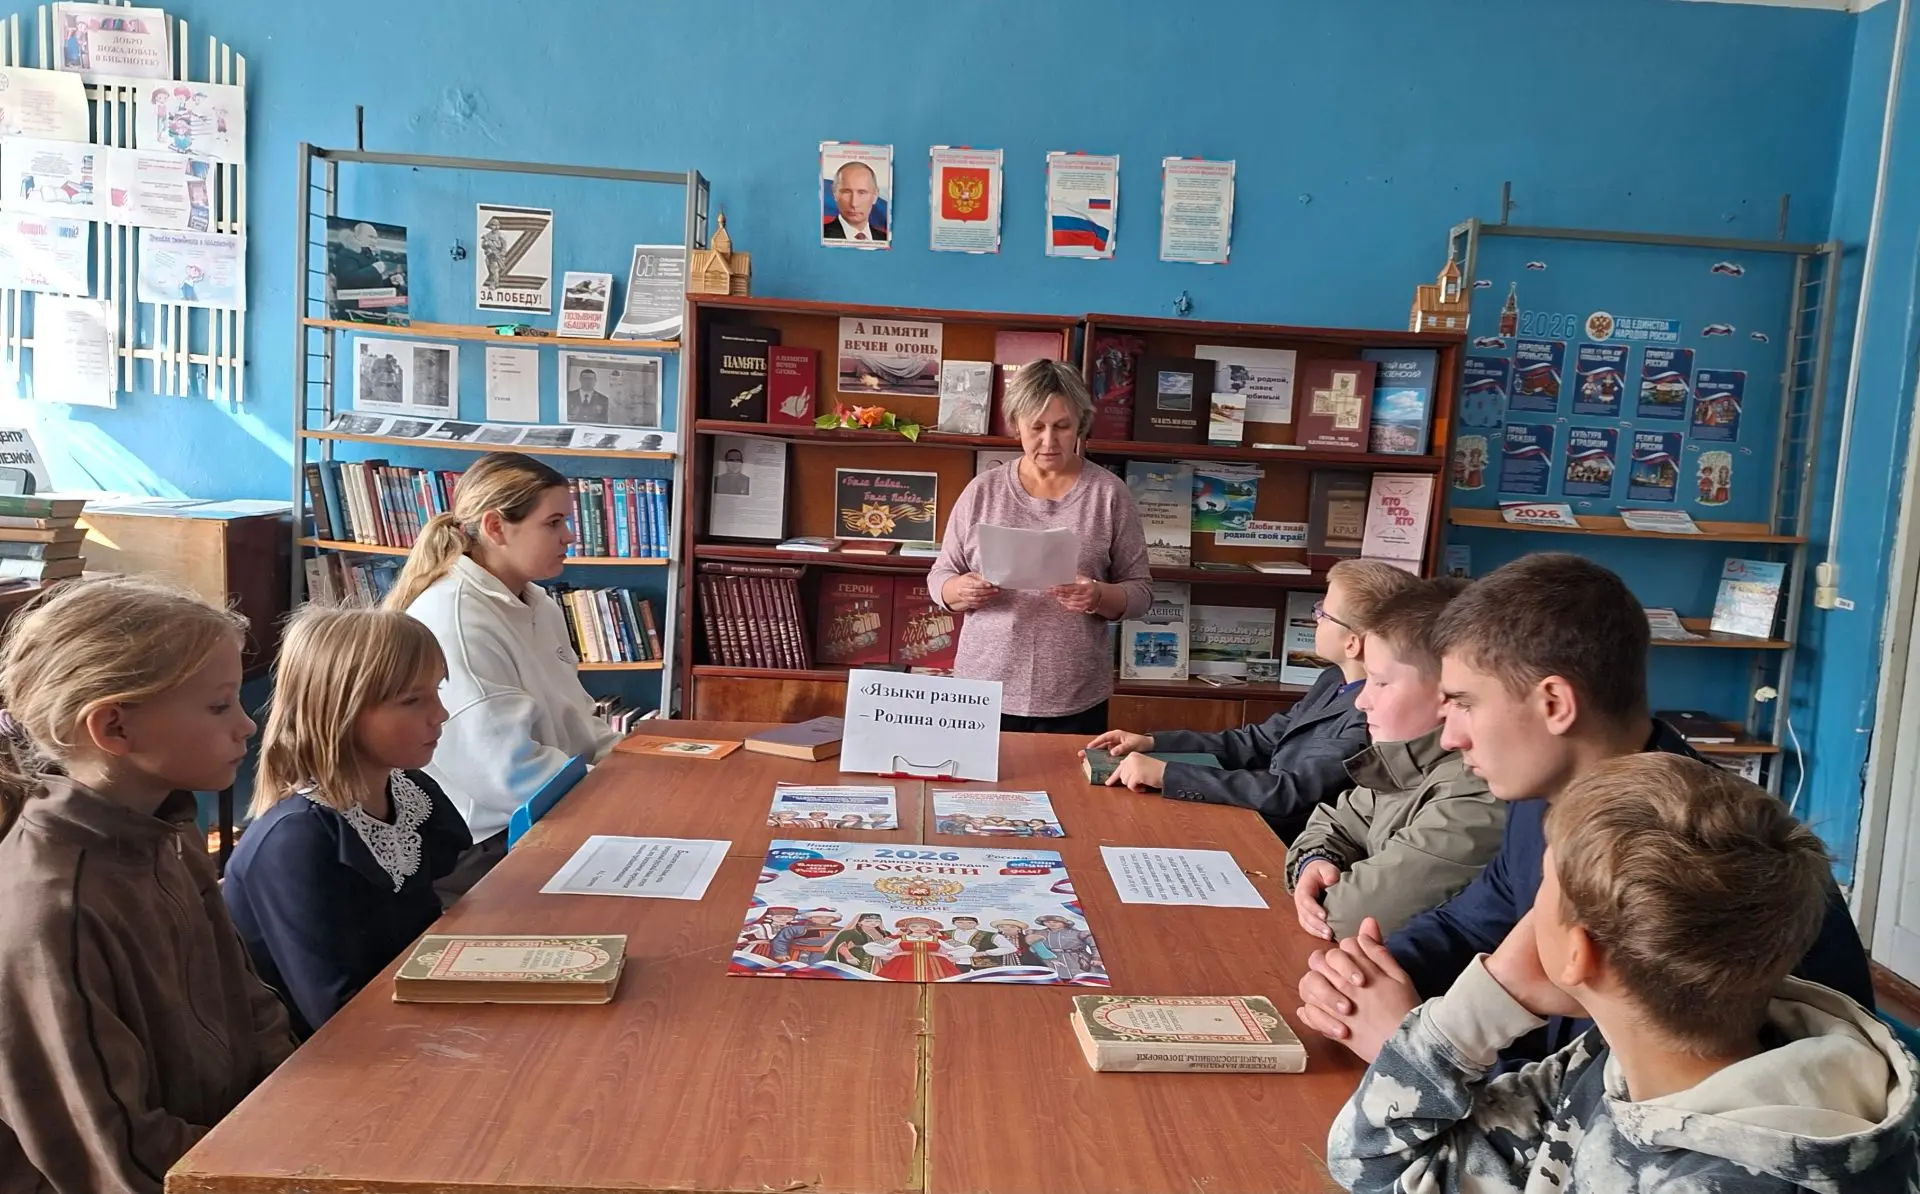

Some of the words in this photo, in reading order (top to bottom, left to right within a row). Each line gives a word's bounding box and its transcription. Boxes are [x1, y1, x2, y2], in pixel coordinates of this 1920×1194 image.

[480, 290, 494, 301] ЗА
[496, 292, 542, 306] ПОБЕДУ!
[854, 321, 866, 335] А
[872, 325, 929, 338] ПАМЯТИ
[1520, 309, 1576, 340] 2026
[844, 339, 888, 352] ВЕЧЕН
[895, 342, 938, 355] ОГОНЬ
[723, 355, 767, 370] ПАМЯТЬ
[1257, 376, 1289, 384] родной,
[1381, 496, 1401, 506] КТО
[1387, 507, 1410, 517] ЕСТЬ
[1514, 508, 1561, 519] 2026
[1247, 522, 1274, 531] Люби
[1283, 524, 1304, 532] знай
[1395, 517, 1415, 526] КТО
[1223, 531, 1256, 540] родной
[1258, 532, 1279, 540] свой
[1280, 533, 1306, 542] край!
[838, 583, 874, 594] ГЕРОИ
[1200, 623, 1217, 634] той
[1253, 628, 1272, 638] где
[860, 682, 925, 700] «Языки
[930, 691, 991, 706] разные
[874, 708, 933, 726] Родина
[938, 717, 986, 731] одна»
[874, 849, 960, 861] 2026
[856, 863, 980, 876] РОССИИ
